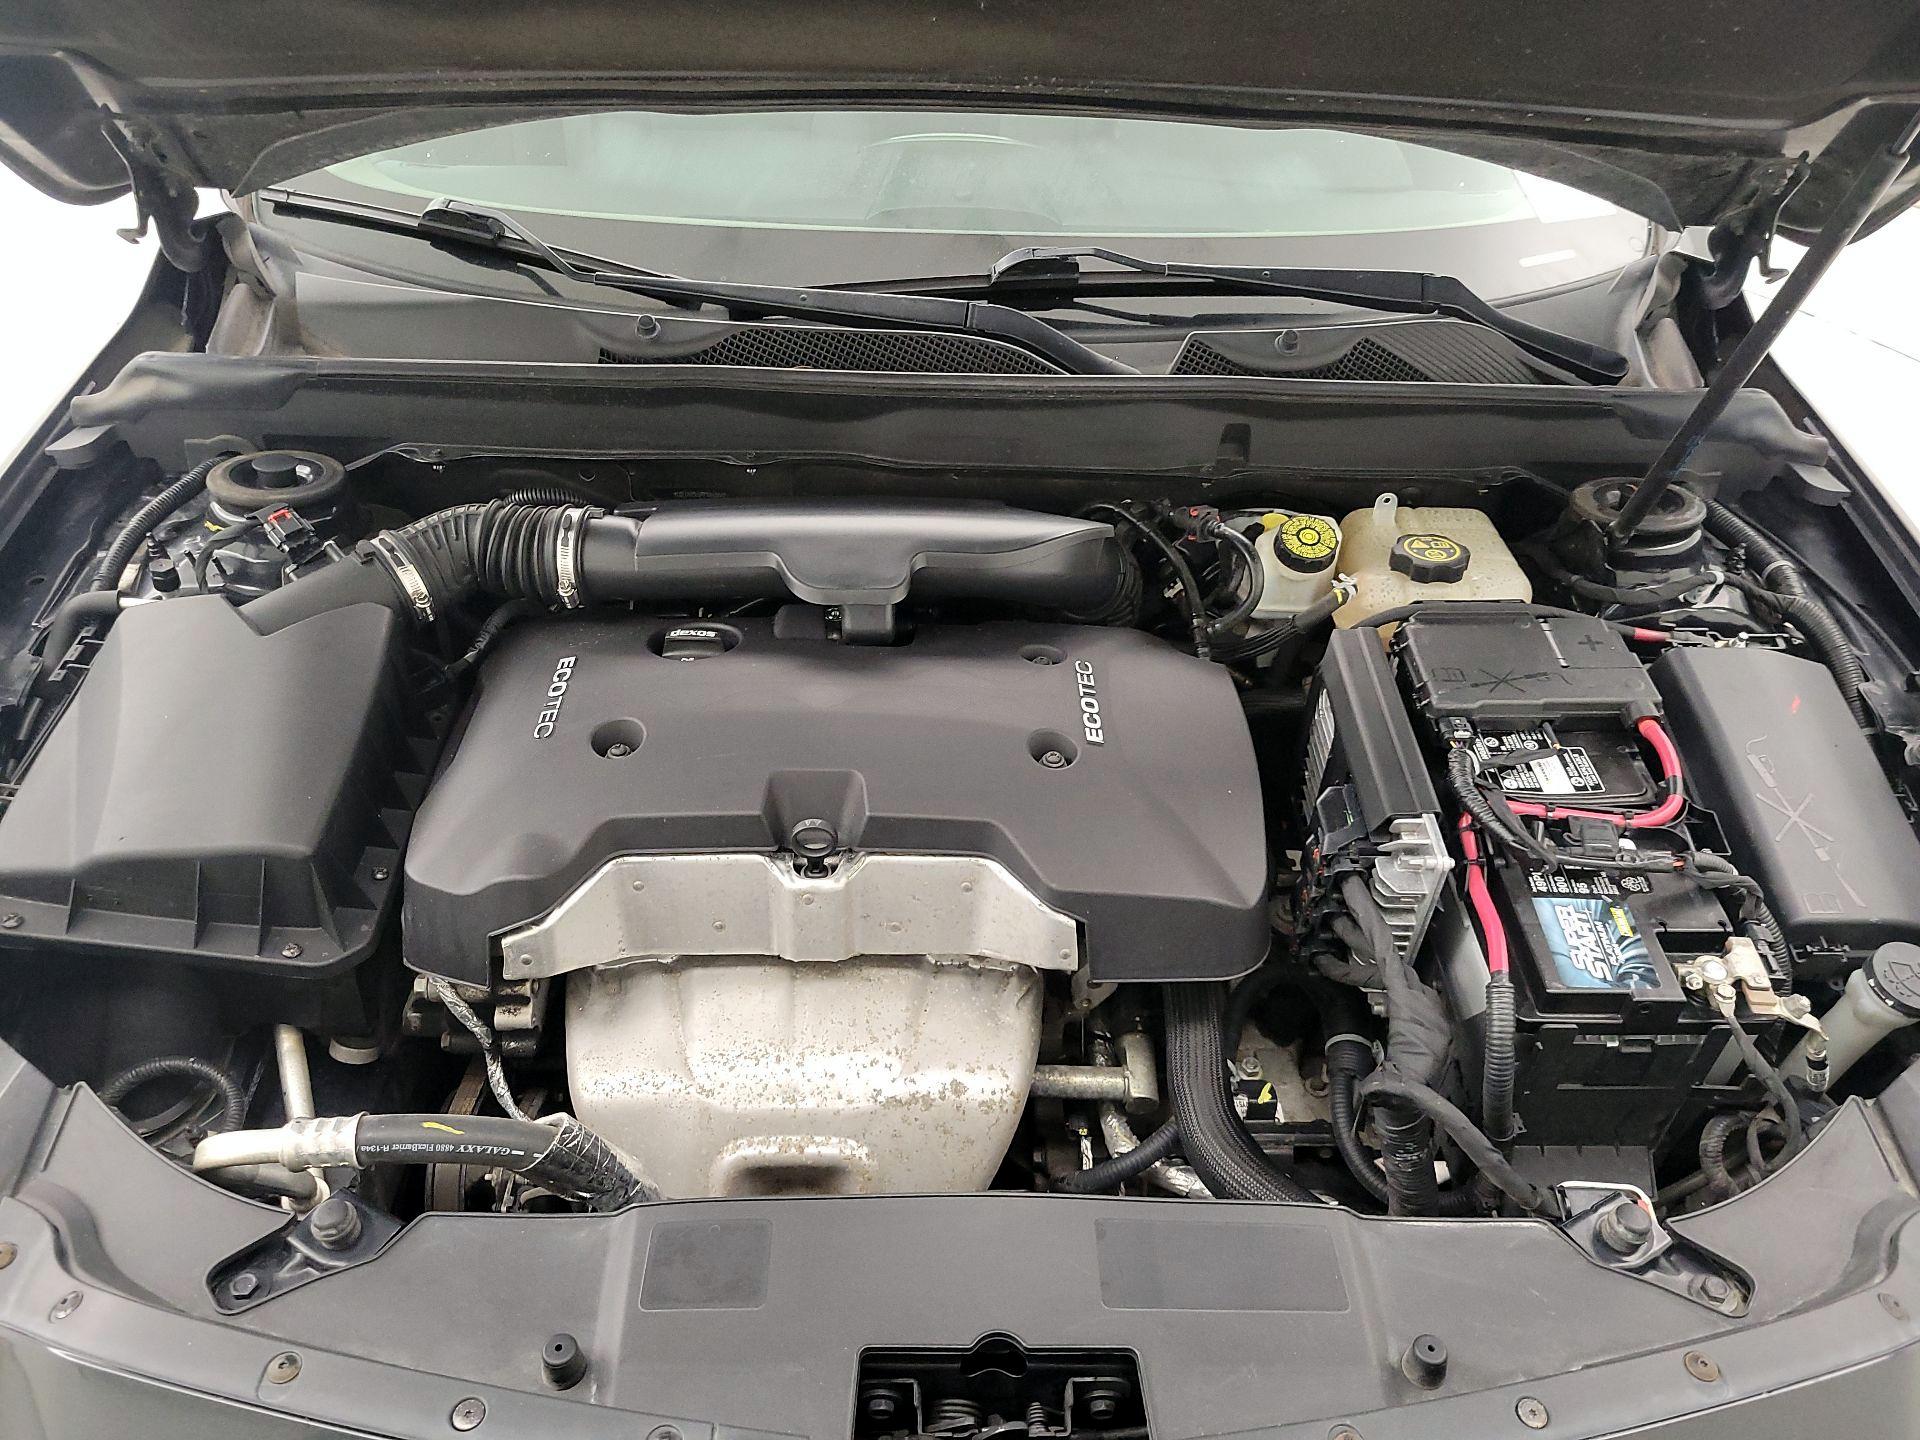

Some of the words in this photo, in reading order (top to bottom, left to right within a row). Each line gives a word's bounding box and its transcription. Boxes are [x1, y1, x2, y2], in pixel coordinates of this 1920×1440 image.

[670, 628, 718, 638] dexos
[533, 655, 577, 739] ECOTEC
[1075, 660, 1105, 744] ECOTEC
[1554, 876, 1570, 893] 900
[1554, 904, 1589, 971] SUPER
[1574, 911, 1613, 982] START
[456, 1143, 511, 1156] GALAXY
